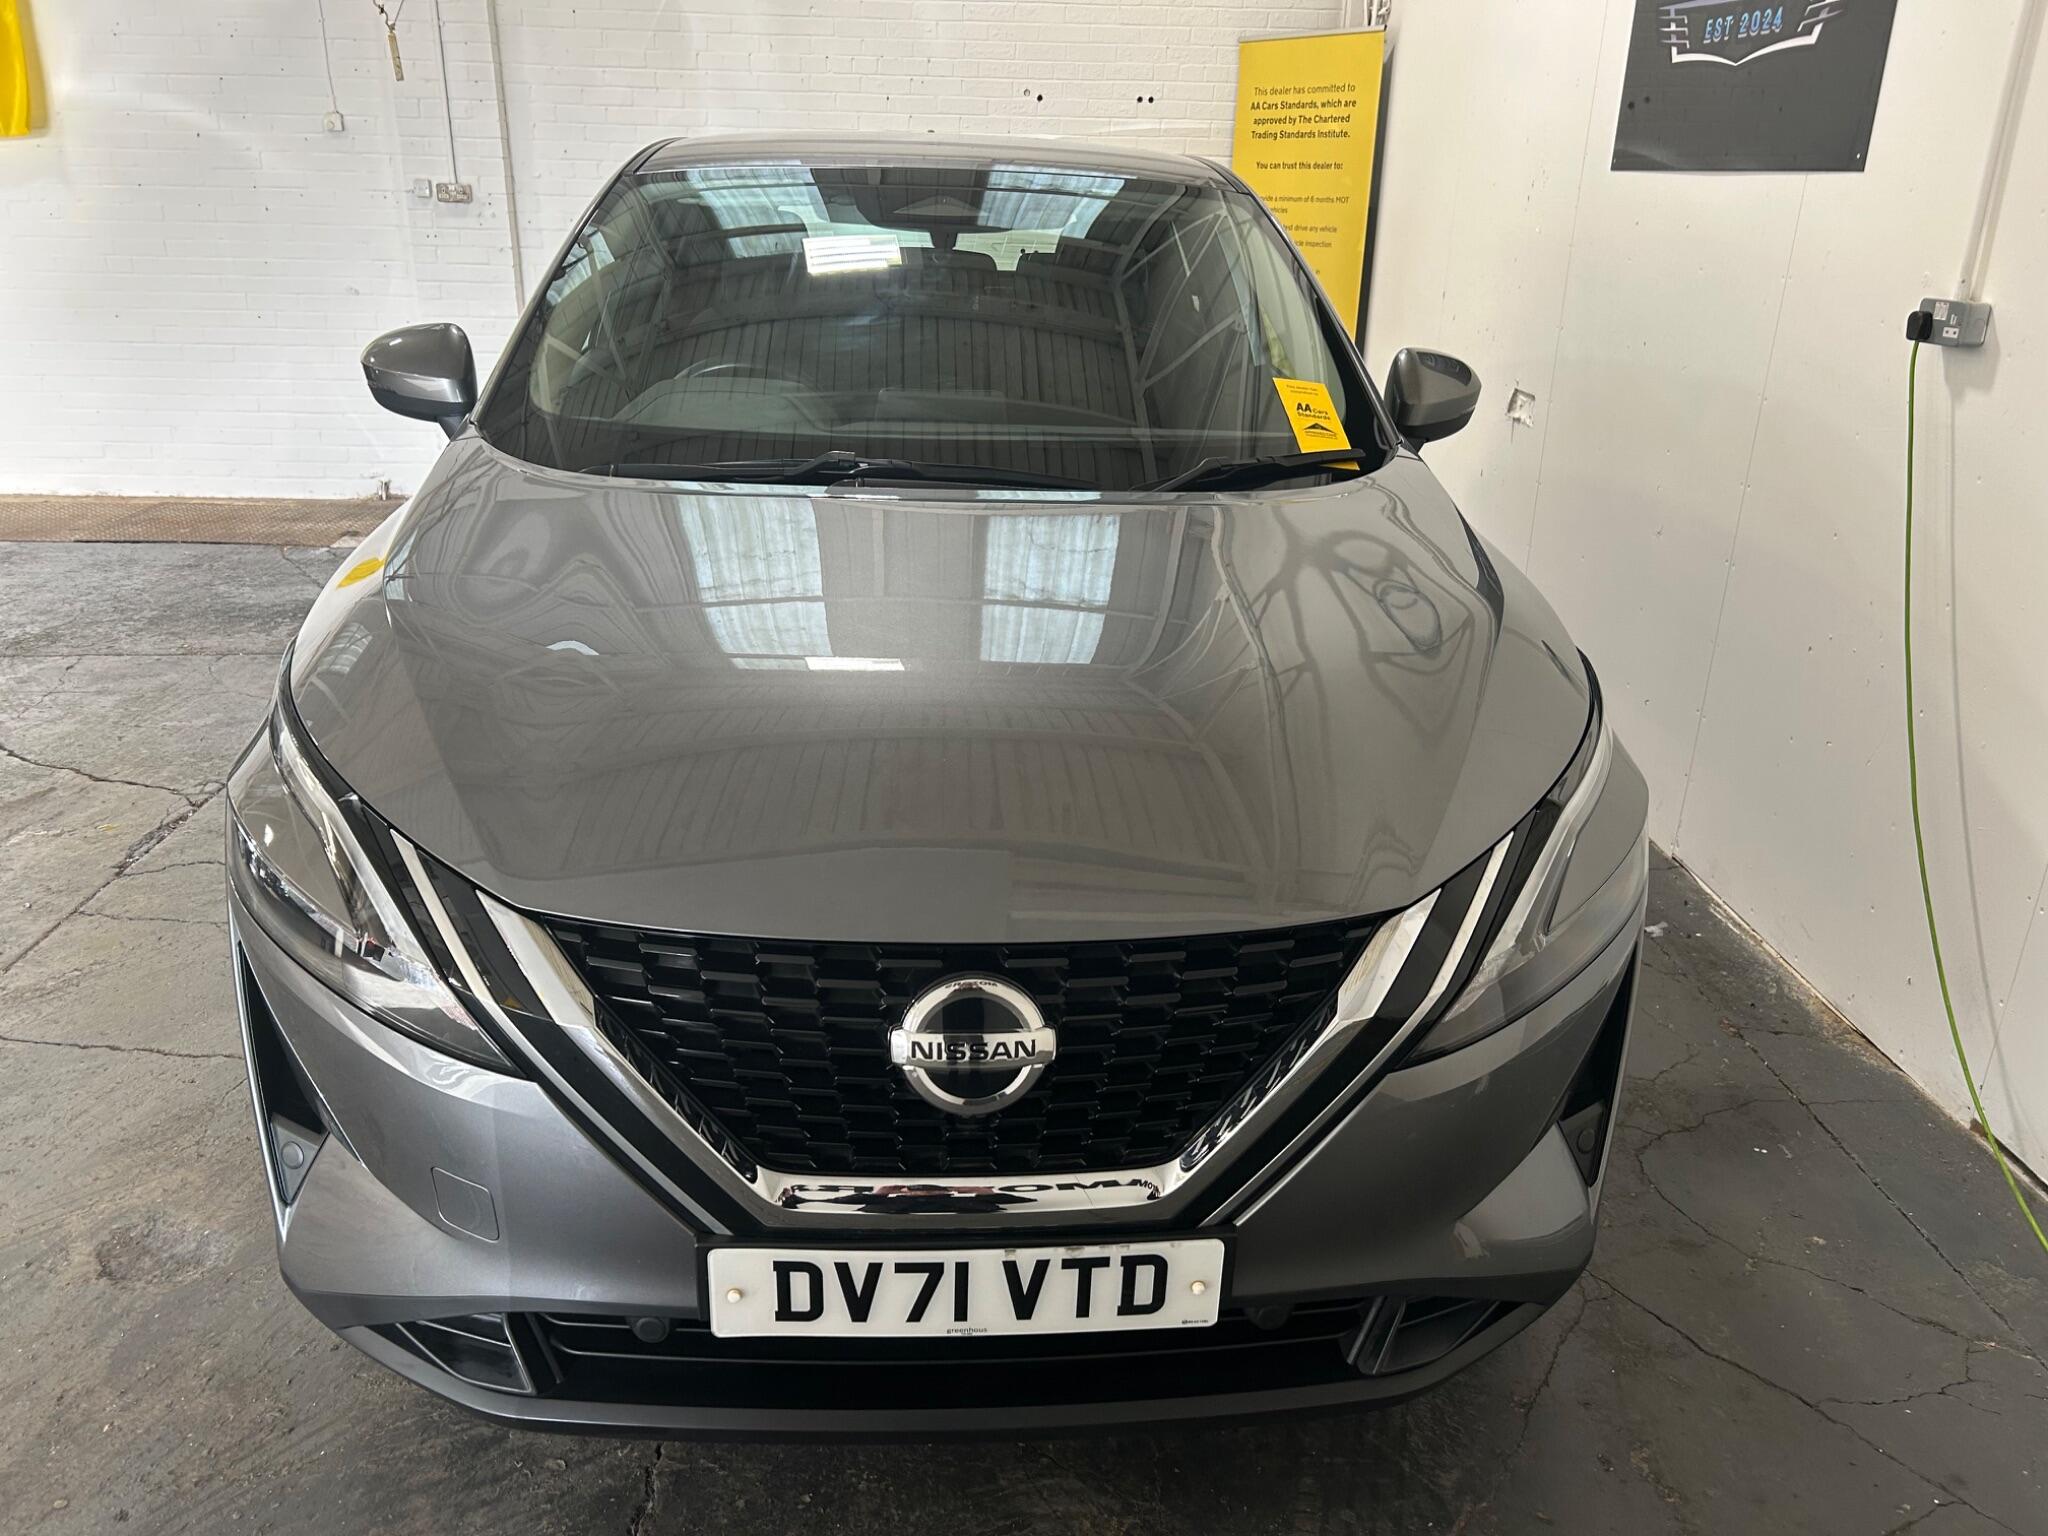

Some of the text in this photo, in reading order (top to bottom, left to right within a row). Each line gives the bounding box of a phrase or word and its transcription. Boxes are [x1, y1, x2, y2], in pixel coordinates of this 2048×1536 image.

[1703, 6, 1784, 44] EST 2024
[1254, 84, 1356, 96] This dealer has committed to
[1250, 102, 1260, 110] AA
[1262, 102, 1278, 110] Cars
[1280, 100, 1319, 110] Standards,
[1320, 99, 1342, 108] which
[1253, 114, 1350, 126] approved by The Chartered
[1251, 130, 1350, 140] Trading Standards Institute.
[1256, 162, 1268, 170] You
[1282, 162, 1297, 170] trust
[1298, 162, 1311, 170] this
[1312, 162, 1333, 170] dealer
[1334, 162, 1344, 170] to:
[1336, 196, 1349, 204] MOT
[1320, 225, 1337, 233] vehicle
[1296, 402, 1312, 413] AA
[911, 1038, 1037, 1061] NISSAN
[772, 1253, 1169, 1324] DV71 VTD
